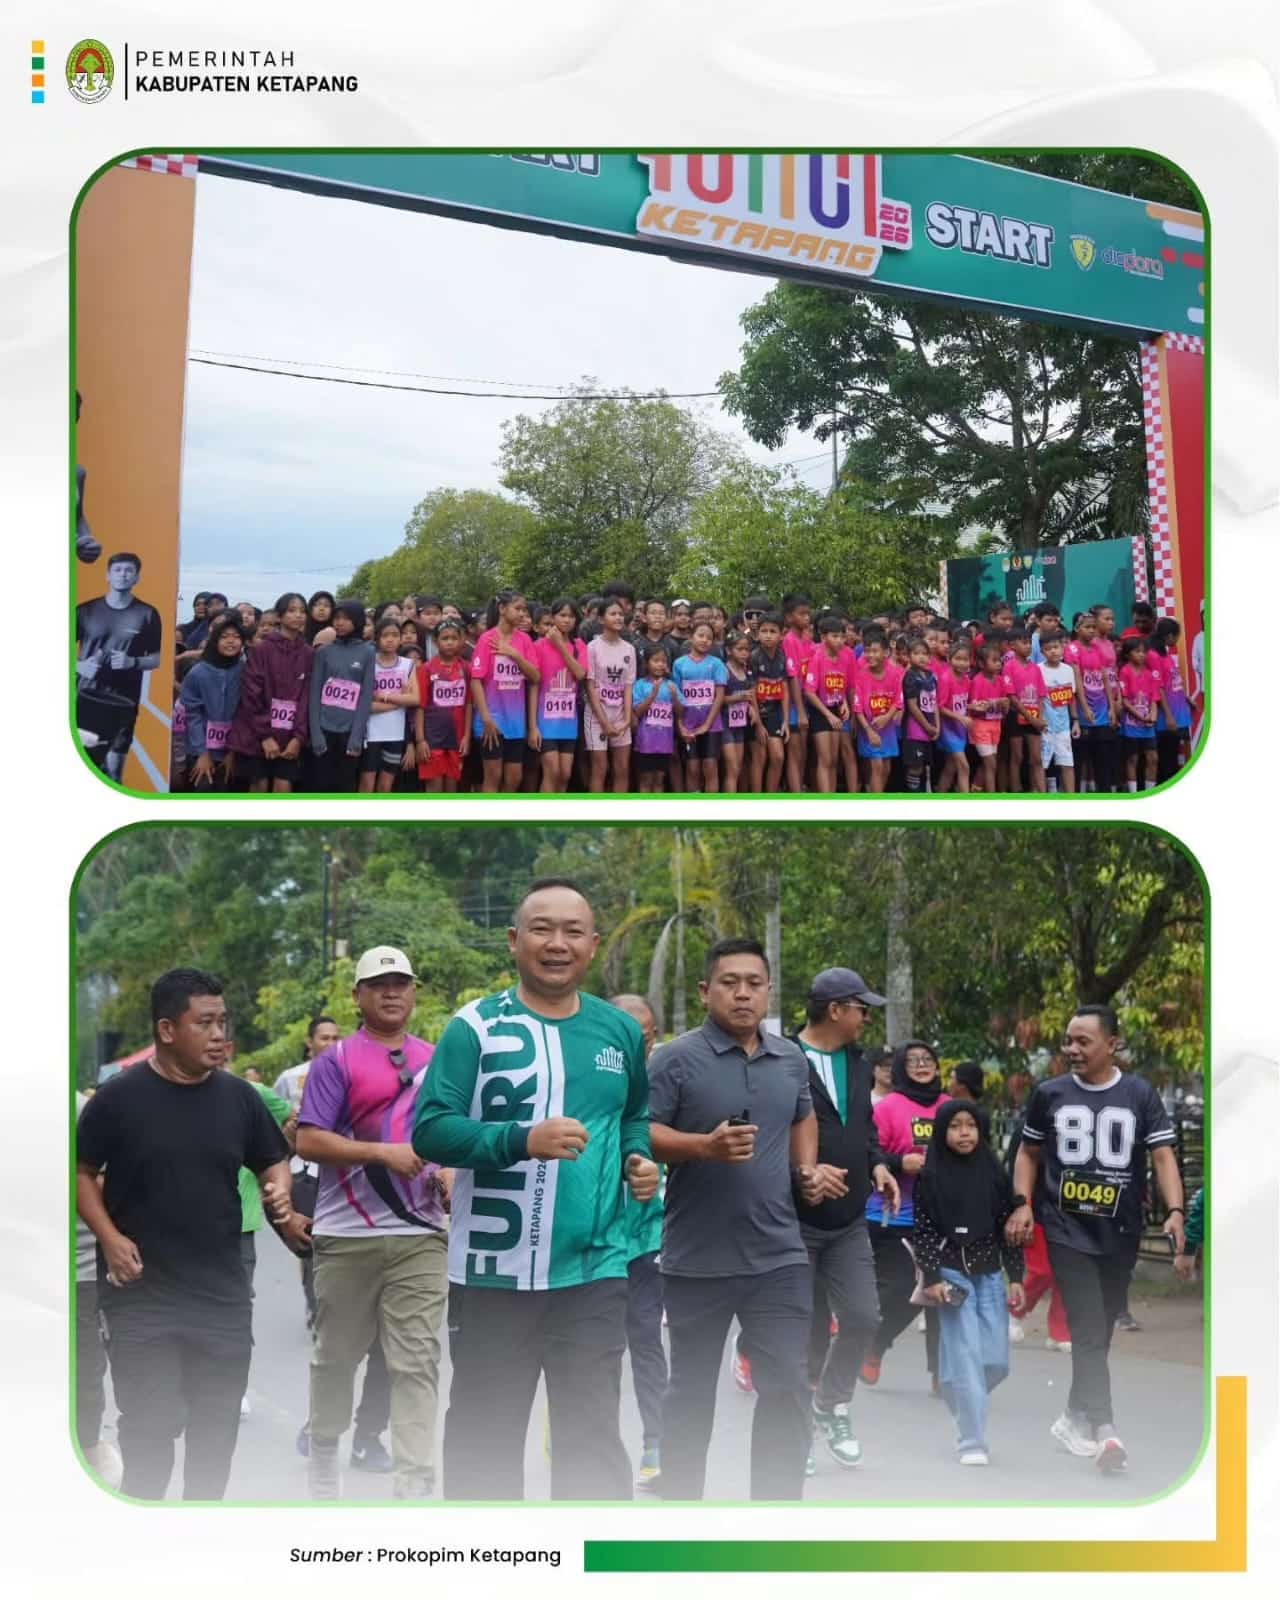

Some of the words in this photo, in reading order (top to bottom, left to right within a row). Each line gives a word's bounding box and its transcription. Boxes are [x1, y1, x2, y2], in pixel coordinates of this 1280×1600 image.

[640, 202, 878, 271] KETAPANG
[926, 202, 1053, 267] START
[324, 685, 356, 702] 0021
[435, 686, 465, 699] 0057
[683, 687, 712, 699] 0033
[545, 701, 572, 712] 0101
[1054, 1104, 1137, 1168] 80
[1063, 1181, 1116, 1205] 0049
[529, 1187, 545, 1247] KETAPANG
